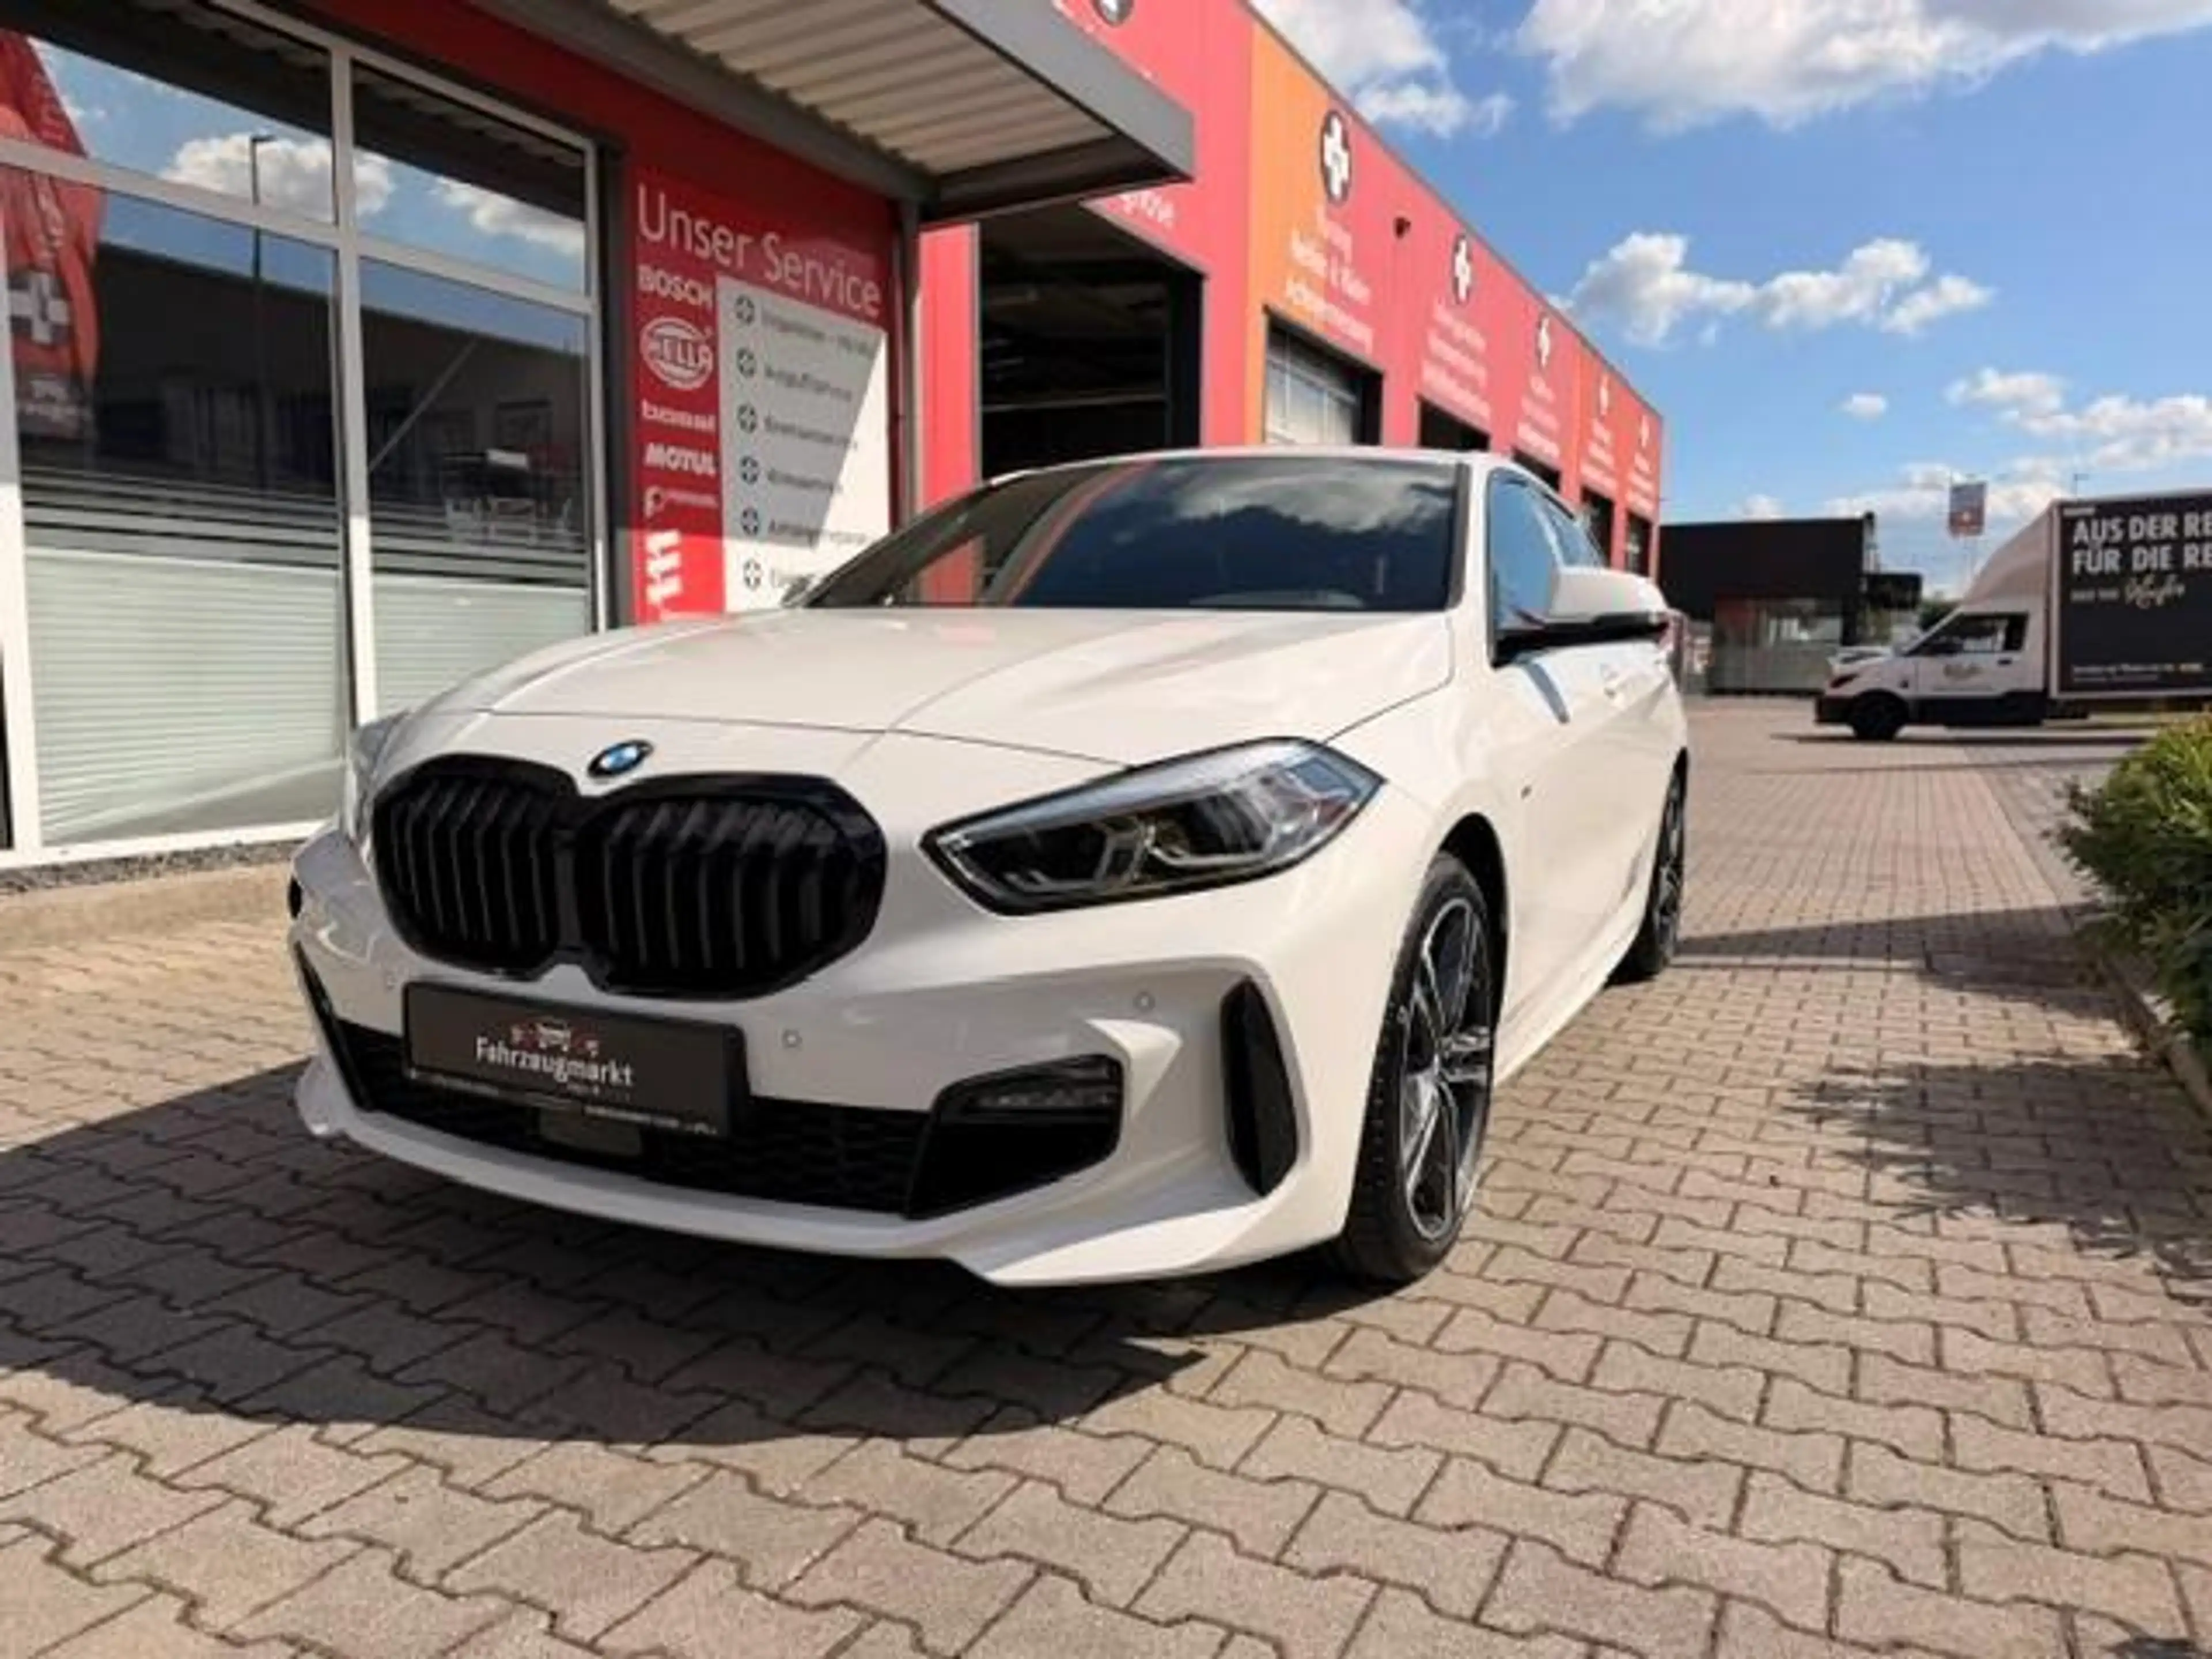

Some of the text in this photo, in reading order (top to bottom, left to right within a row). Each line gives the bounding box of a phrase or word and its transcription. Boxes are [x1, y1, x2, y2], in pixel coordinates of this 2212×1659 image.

[638, 183, 881, 317] Unser Service
[638, 264, 714, 310] BOSCH
[645, 442, 717, 479] MOTUL
[2073, 517, 2124, 544] AUS
[2129, 514, 2179, 540] DER
[2073, 540, 2122, 575] FÜR
[2132, 545, 2172, 573] DIE
